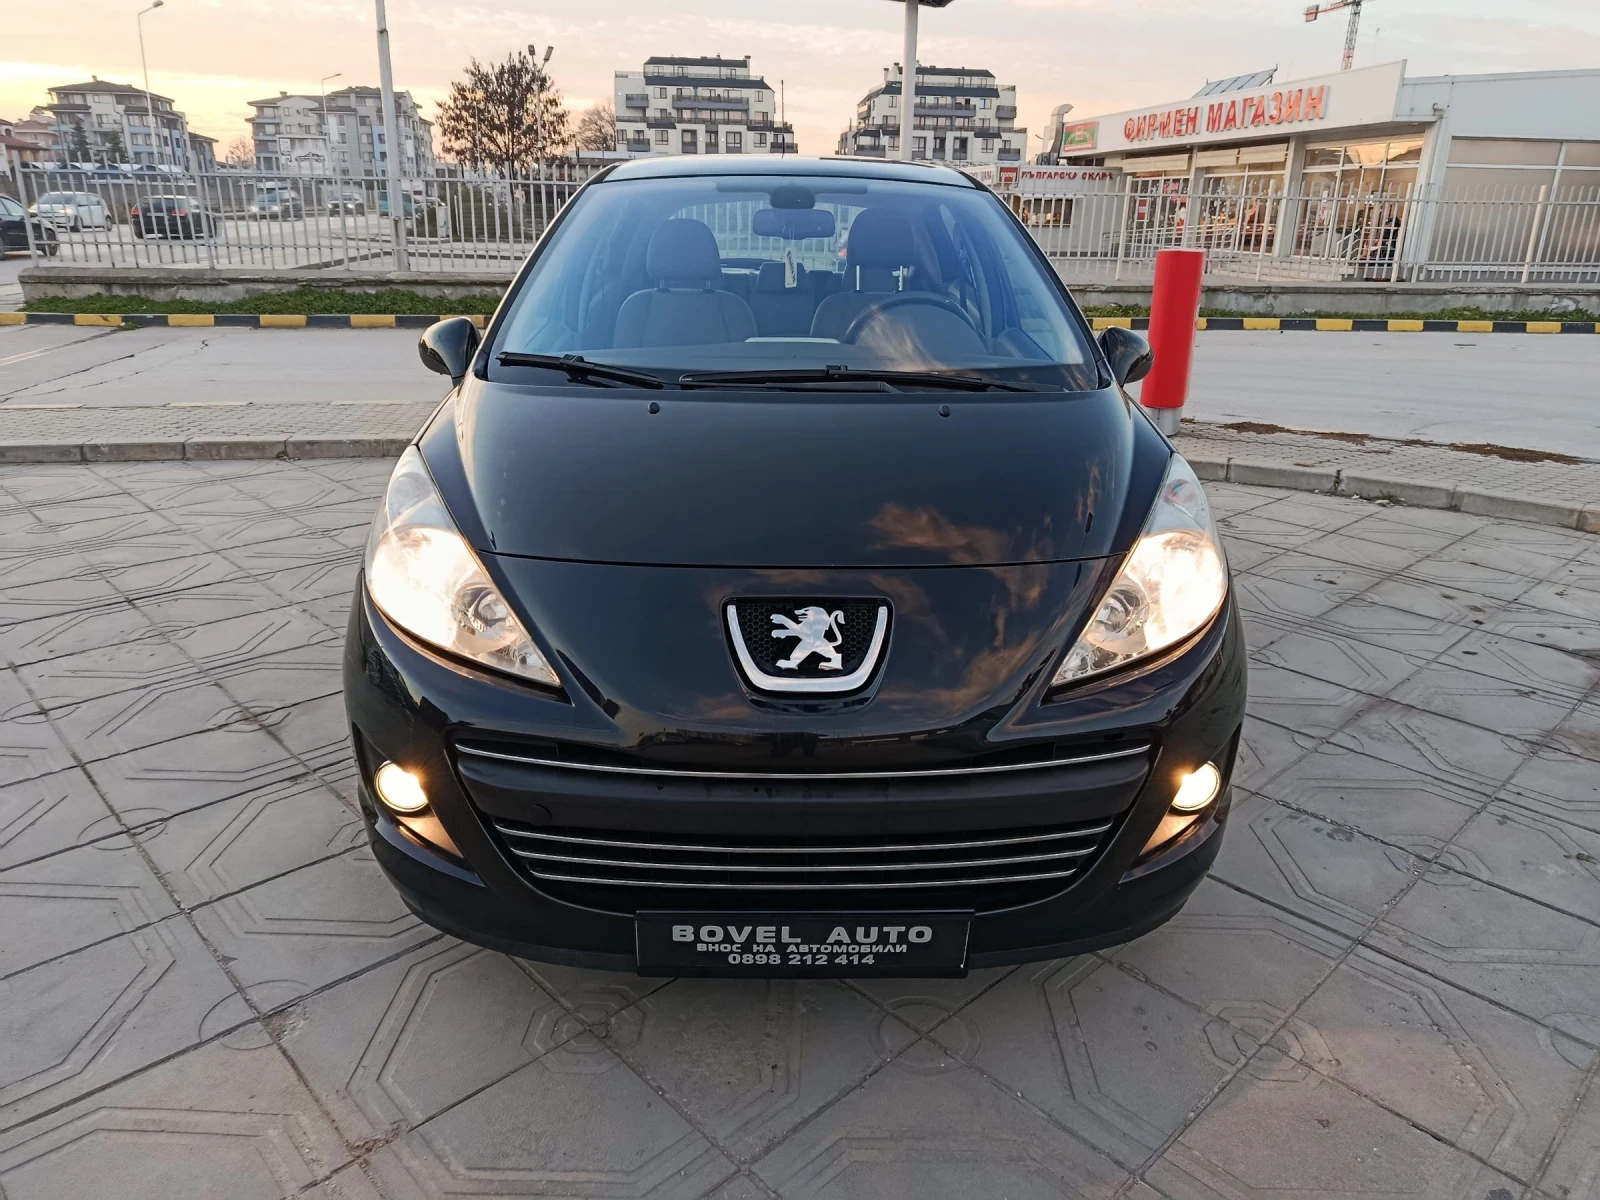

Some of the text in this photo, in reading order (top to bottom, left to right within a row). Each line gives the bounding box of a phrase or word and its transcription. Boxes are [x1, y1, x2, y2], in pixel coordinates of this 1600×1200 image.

[1123, 85, 1327, 142] ФИРМЕН МАГАЗИН
[1082, 171, 1114, 180] СКАРА
[672, 925, 933, 943] BOVEL AUTO
[696, 943, 908, 953] ВНОС НА АВТОМОБИЛИ
[728, 954, 874, 965] 0898 212 414
